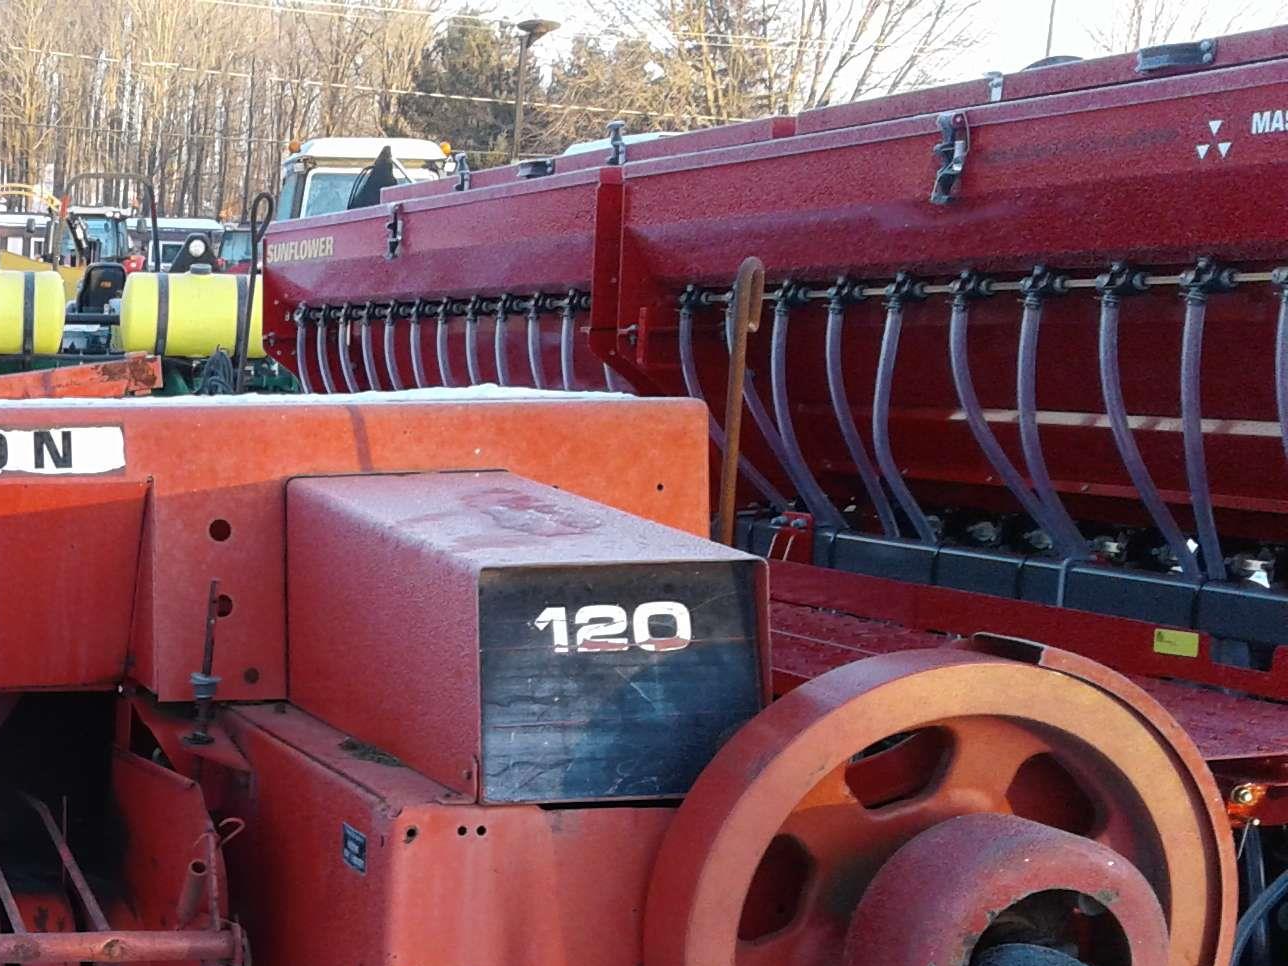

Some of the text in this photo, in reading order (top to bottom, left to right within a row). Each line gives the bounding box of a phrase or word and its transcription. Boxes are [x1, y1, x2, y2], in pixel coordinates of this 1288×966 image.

[1251, 110, 1288, 135] MA
[266, 236, 334, 263] SUNFLOWER
[534, 601, 692, 652] 120
